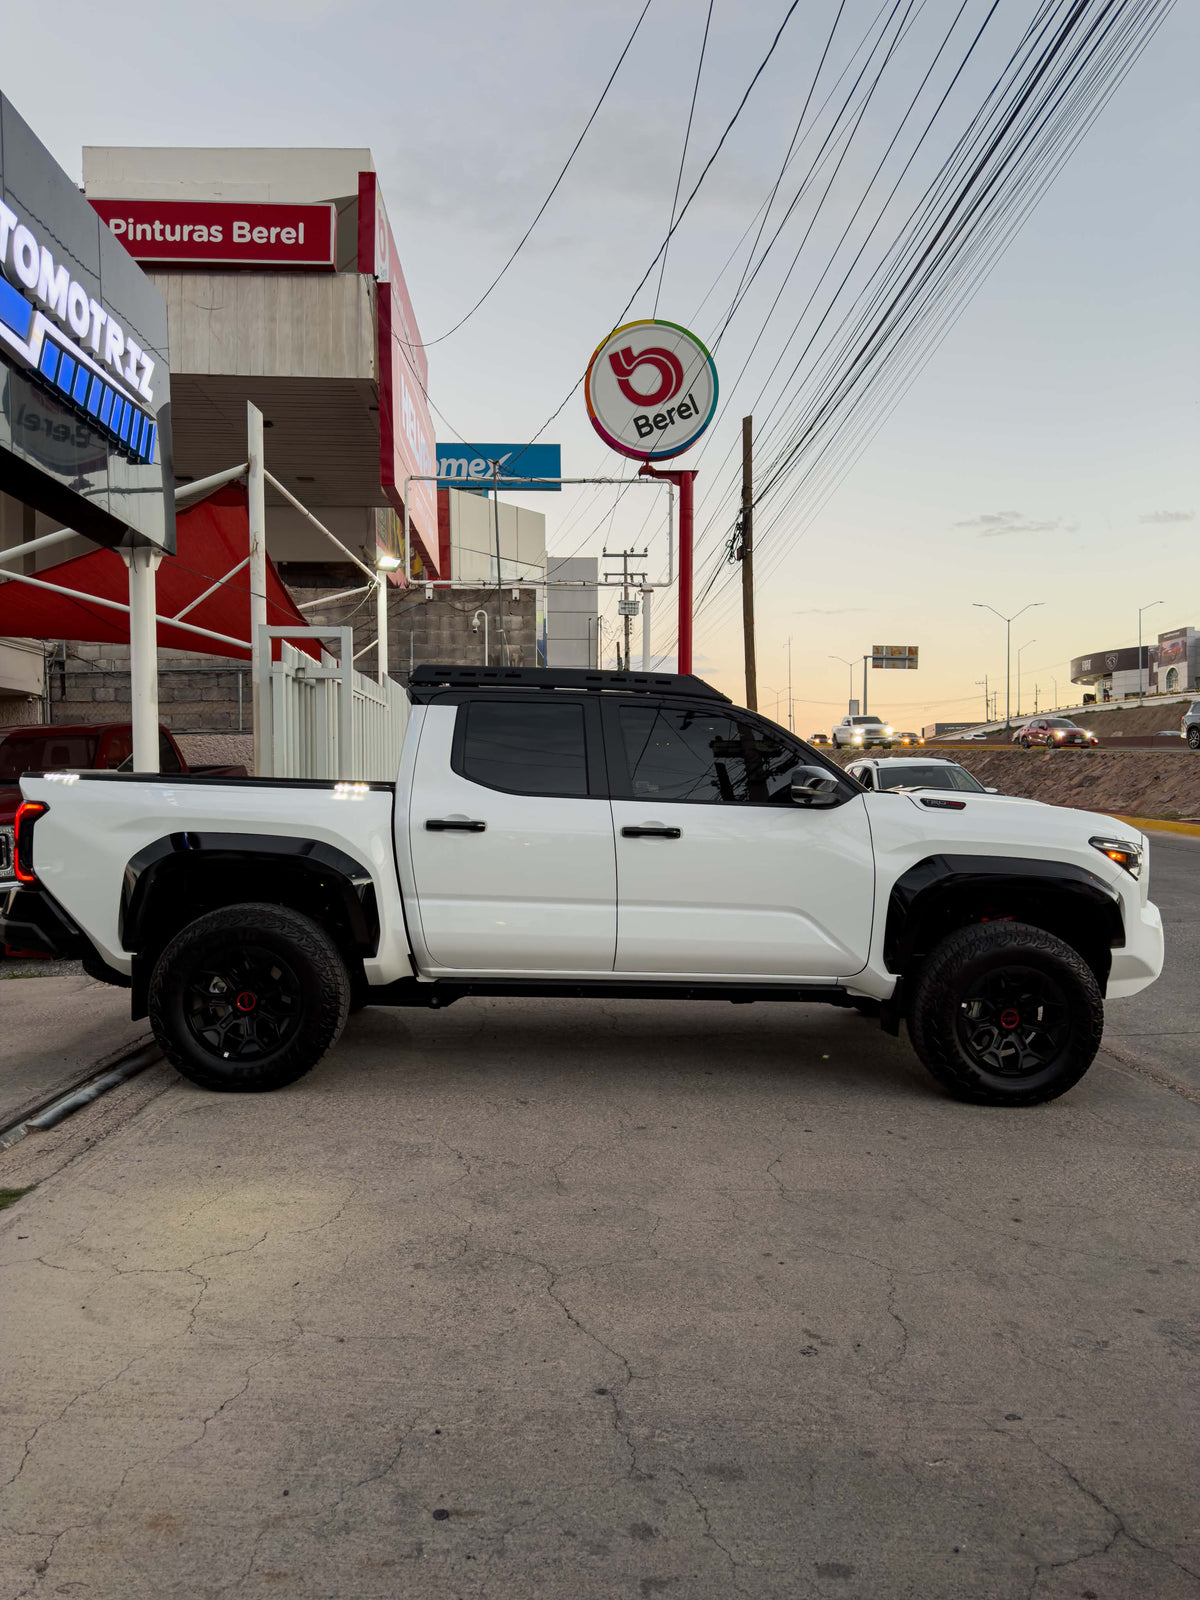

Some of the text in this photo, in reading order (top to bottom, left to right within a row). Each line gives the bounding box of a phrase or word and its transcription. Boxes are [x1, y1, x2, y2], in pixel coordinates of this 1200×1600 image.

[109, 218, 305, 245] Pinturas Berel
[633, 393, 699, 438] Berel
[436, 452, 513, 477] mex
